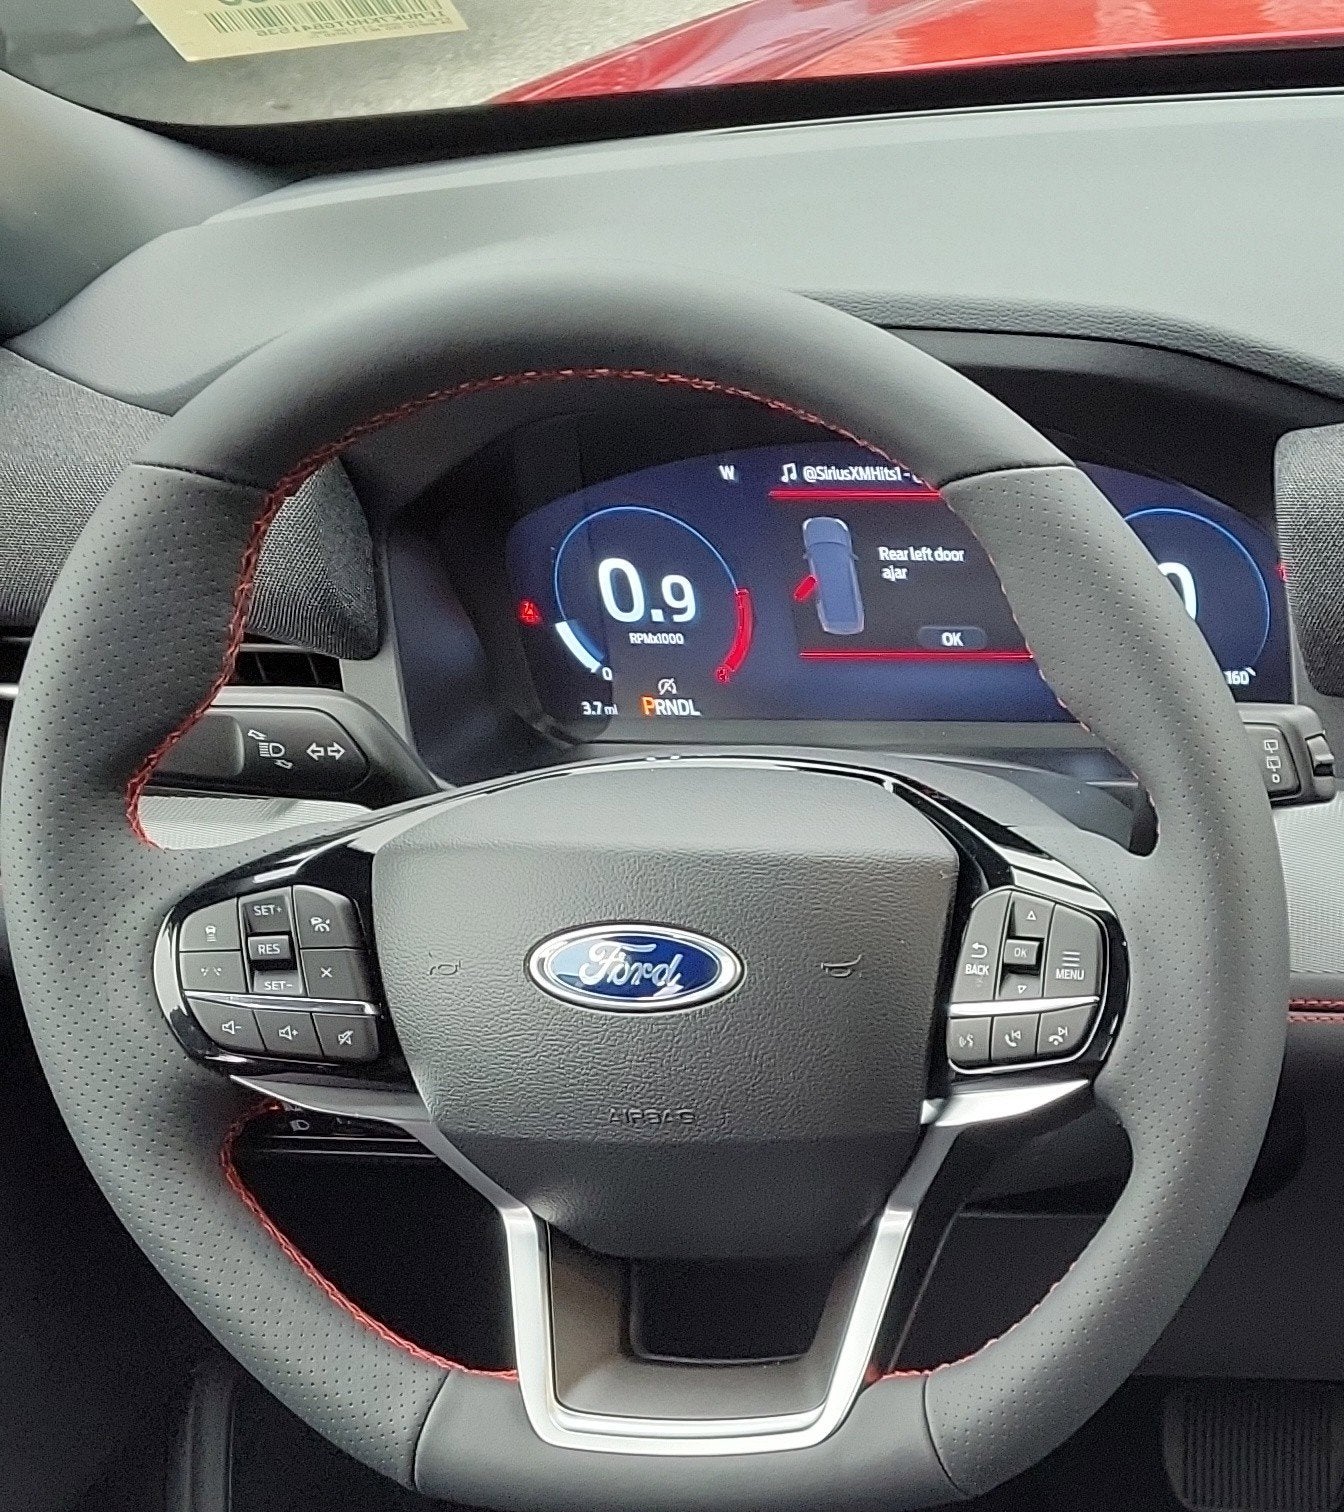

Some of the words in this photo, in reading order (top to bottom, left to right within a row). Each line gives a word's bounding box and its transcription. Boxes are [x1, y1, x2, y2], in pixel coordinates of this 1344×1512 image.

[719, 465, 735, 480] W
[803, 465, 902, 483] @SiriusXMHits1
[879, 546, 909, 561] Rear
[909, 546, 934, 561] left
[934, 546, 965, 562] door
[881, 565, 908, 582] ajar
[598, 557, 697, 624] 0.9
[629, 632, 685, 646] RPMx1000
[942, 632, 964, 647] OK
[602, 667, 612, 680] 0
[581, 701, 602, 715] 3.7
[642, 696, 701, 716] PRNDL
[253, 904, 283, 917] SET+
[257, 943, 280, 955] RES
[1013, 946, 1028, 958] OK
[579, 940, 686, 989] Ford
[965, 964, 990, 976] BACK
[1055, 968, 1085, 981] MENU
